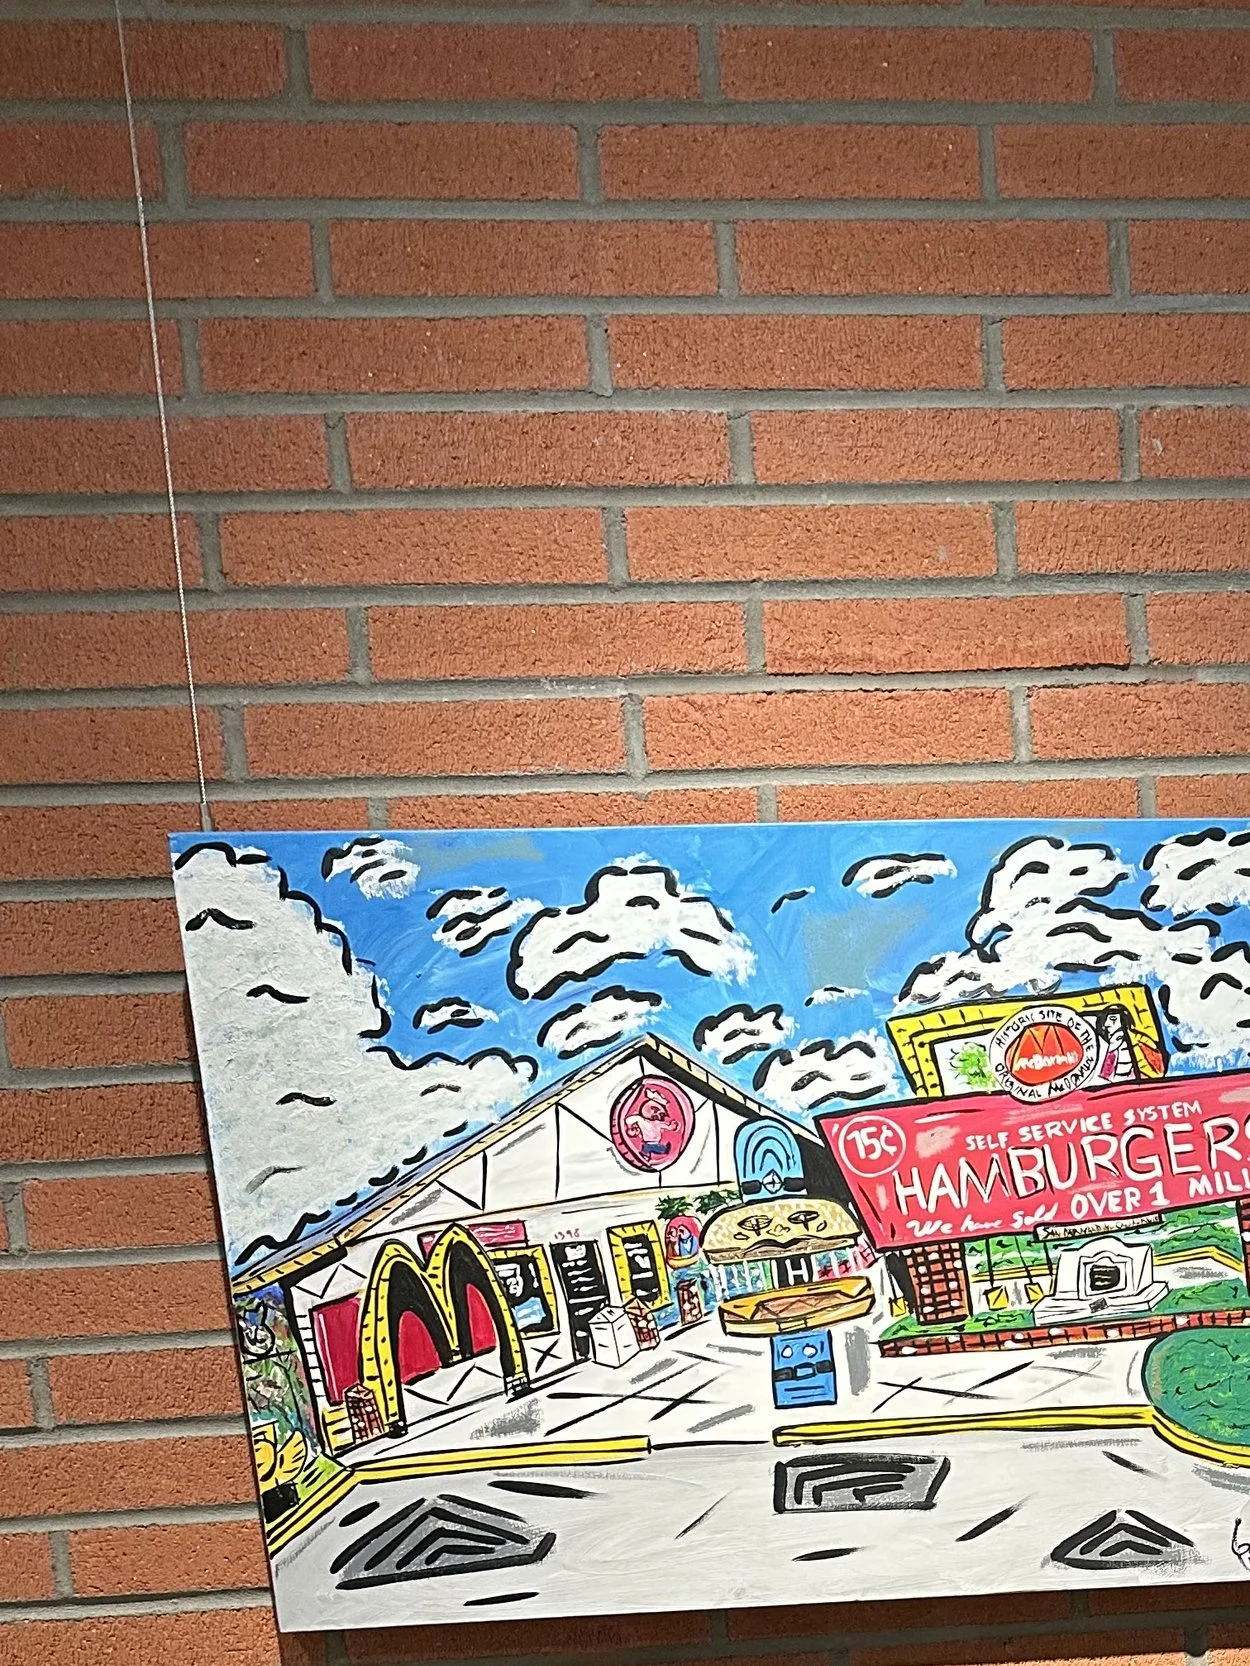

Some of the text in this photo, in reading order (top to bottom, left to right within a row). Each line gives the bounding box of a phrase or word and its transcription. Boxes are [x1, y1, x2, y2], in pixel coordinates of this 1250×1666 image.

[1038, 1009, 1063, 1022] SITE
[1067, 1017, 1081, 1031] OF
[965, 1100, 1202, 1151] SELF SERVICE SYSTEM
[905, 1219, 953, 1238] We
[1070, 1187, 1141, 1219] OVER
[1149, 1181, 1170, 1206] 1
